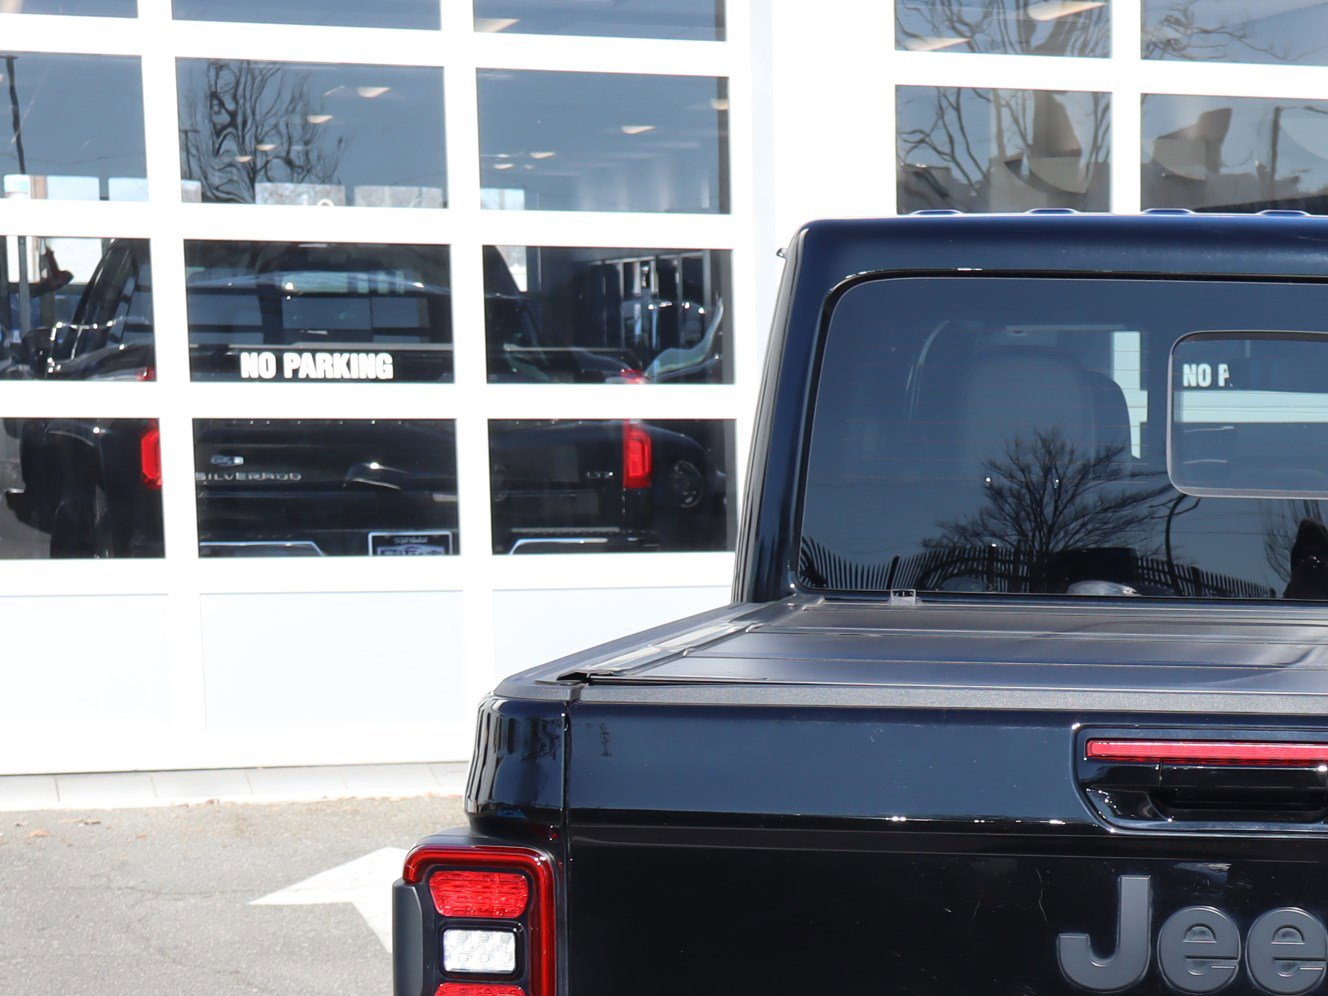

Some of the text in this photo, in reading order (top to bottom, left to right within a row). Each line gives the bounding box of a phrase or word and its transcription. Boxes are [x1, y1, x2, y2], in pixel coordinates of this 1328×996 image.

[240, 352, 394, 379] NO PARKING
[1182, 363, 1212, 388] NO
